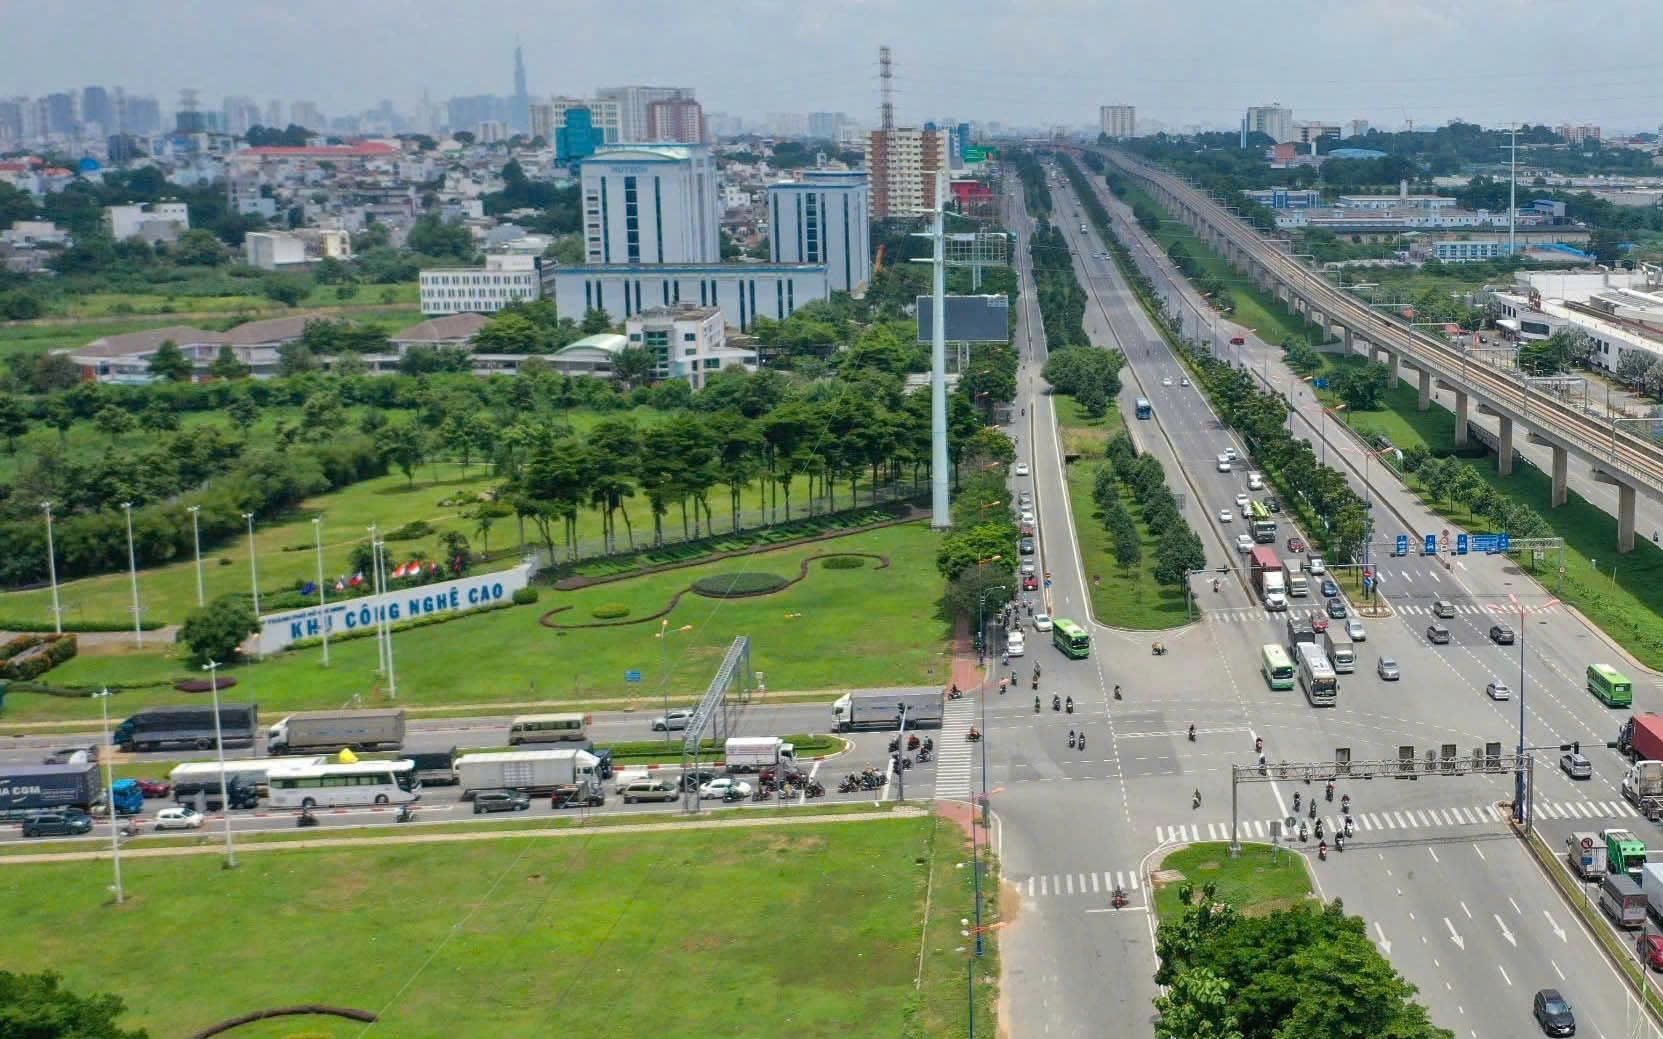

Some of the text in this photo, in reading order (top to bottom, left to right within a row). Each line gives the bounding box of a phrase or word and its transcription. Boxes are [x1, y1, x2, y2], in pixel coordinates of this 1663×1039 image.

[291, 615, 333, 639] KHU
[345, 603, 399, 628] CÔNG
[468, 583, 503, 604] CAO
